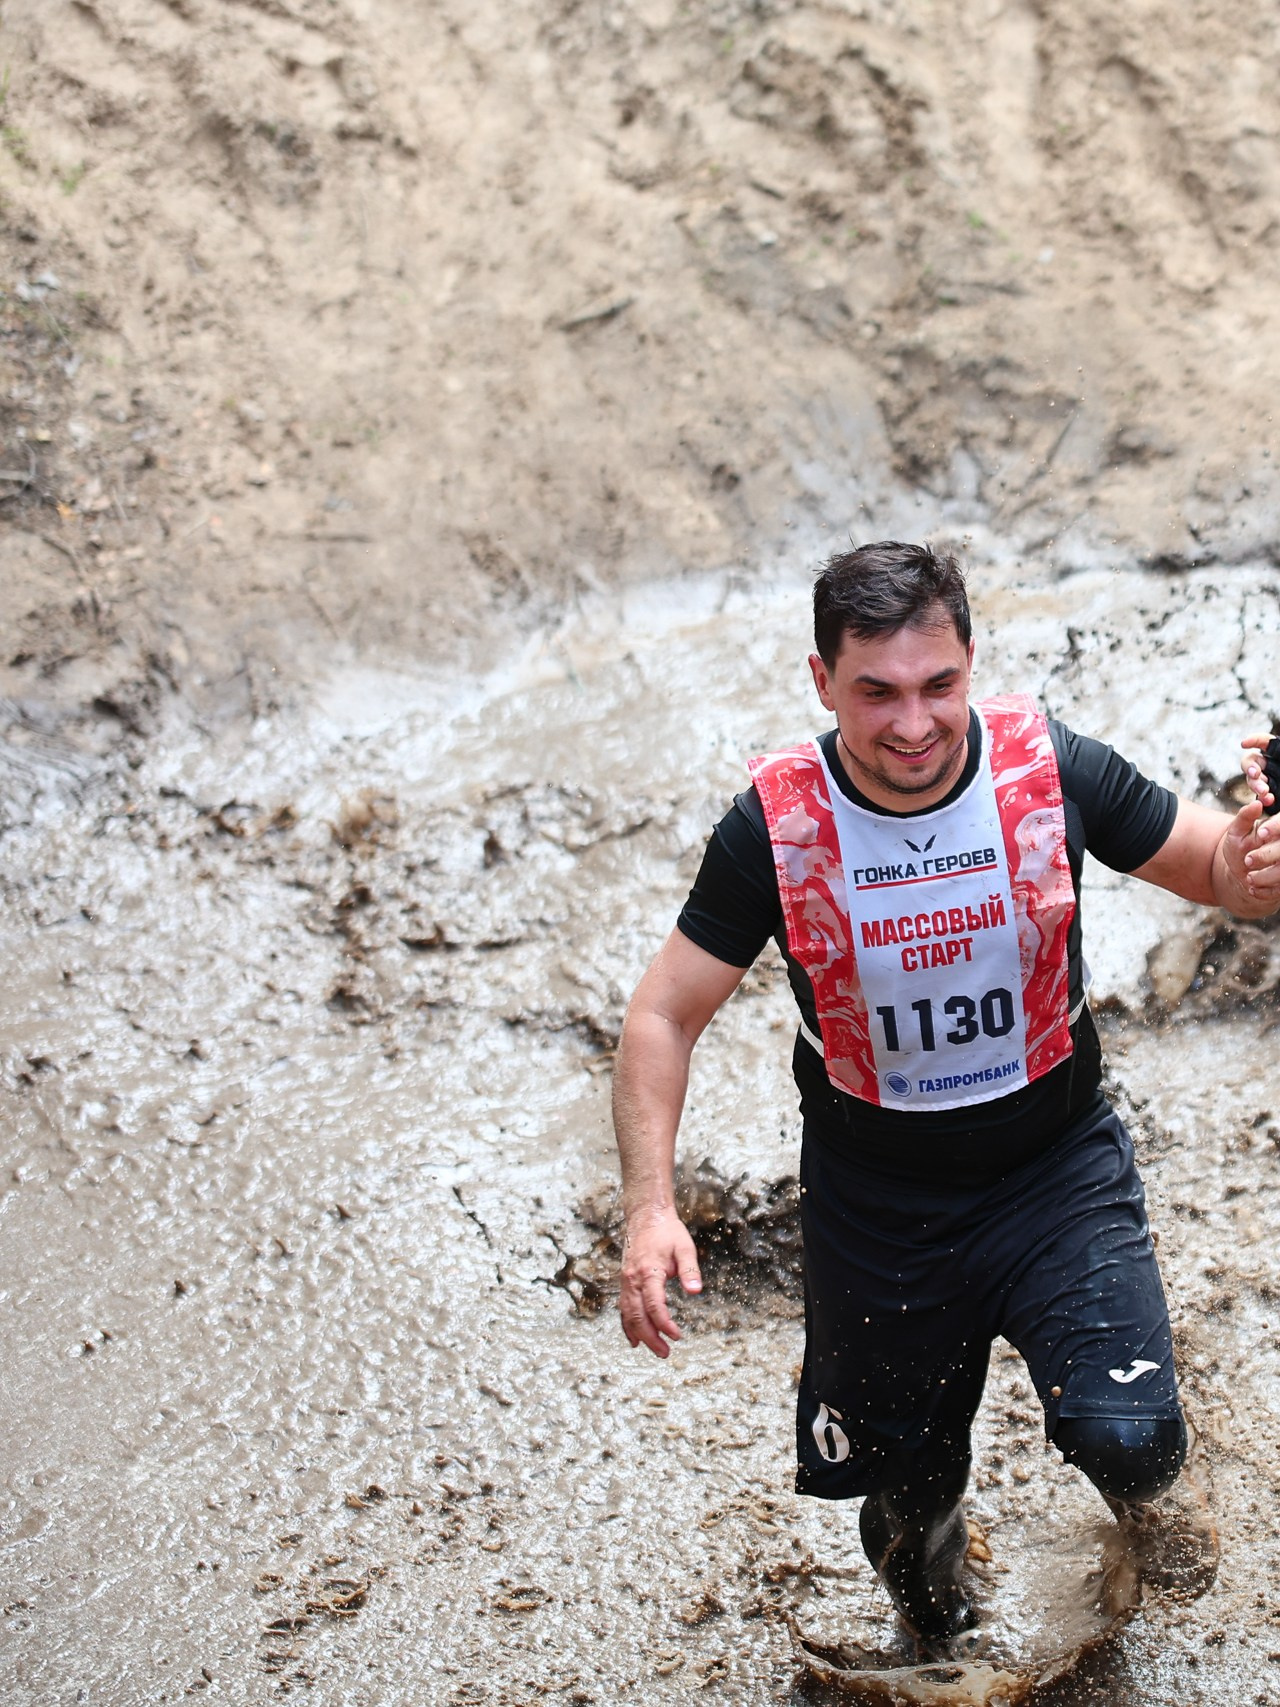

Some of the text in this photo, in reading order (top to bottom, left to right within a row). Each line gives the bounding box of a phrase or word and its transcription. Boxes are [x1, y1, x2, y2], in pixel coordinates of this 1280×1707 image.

[853, 847, 997, 885] ГОНКА ГЕРОЕВ
[861, 893, 1007, 949] МАССОВЫЙ
[901, 938, 974, 973] СТАРТ
[876, 987, 1016, 1052] 1130
[918, 1059, 1021, 1094] ГАЗПРОМБАНК
[812, 1402, 851, 1463] 6
